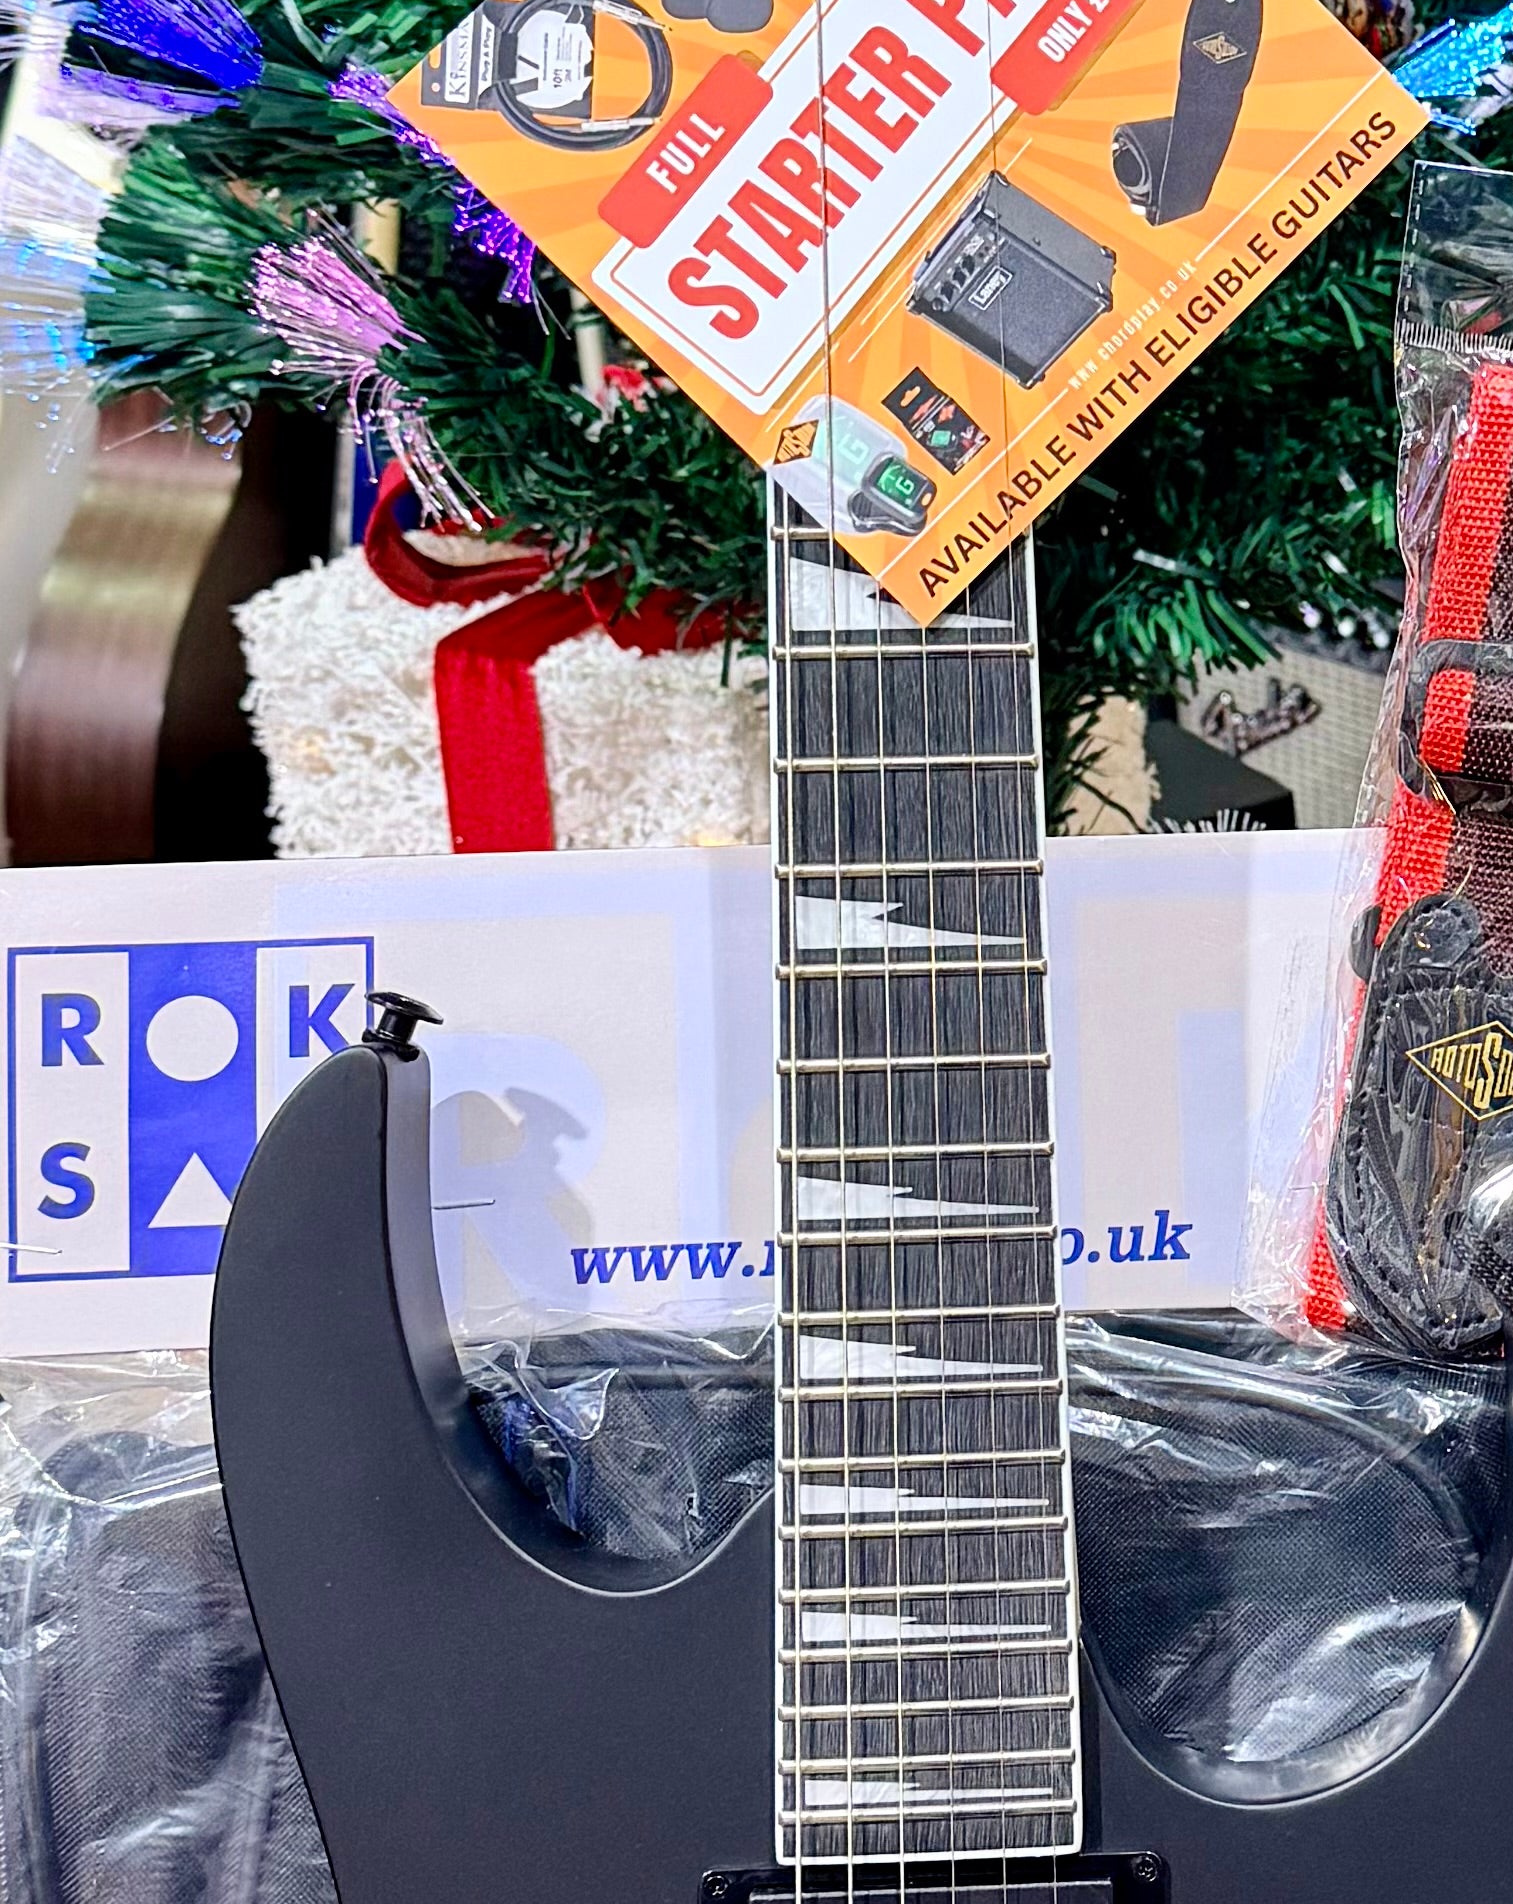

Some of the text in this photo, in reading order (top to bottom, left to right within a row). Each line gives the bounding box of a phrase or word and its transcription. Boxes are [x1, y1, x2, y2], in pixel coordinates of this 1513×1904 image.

[1037, 0, 1093, 63] ONLY
[646, 113, 725, 195] FULL
[668, 25, 952, 340] STARTER
[918, 436, 1076, 597] AVAILABLE
[1067, 360, 1151, 442] WITH
[1144, 233, 1278, 366] ELIGIBLE
[1272, 112, 1396, 239] GUITARS
